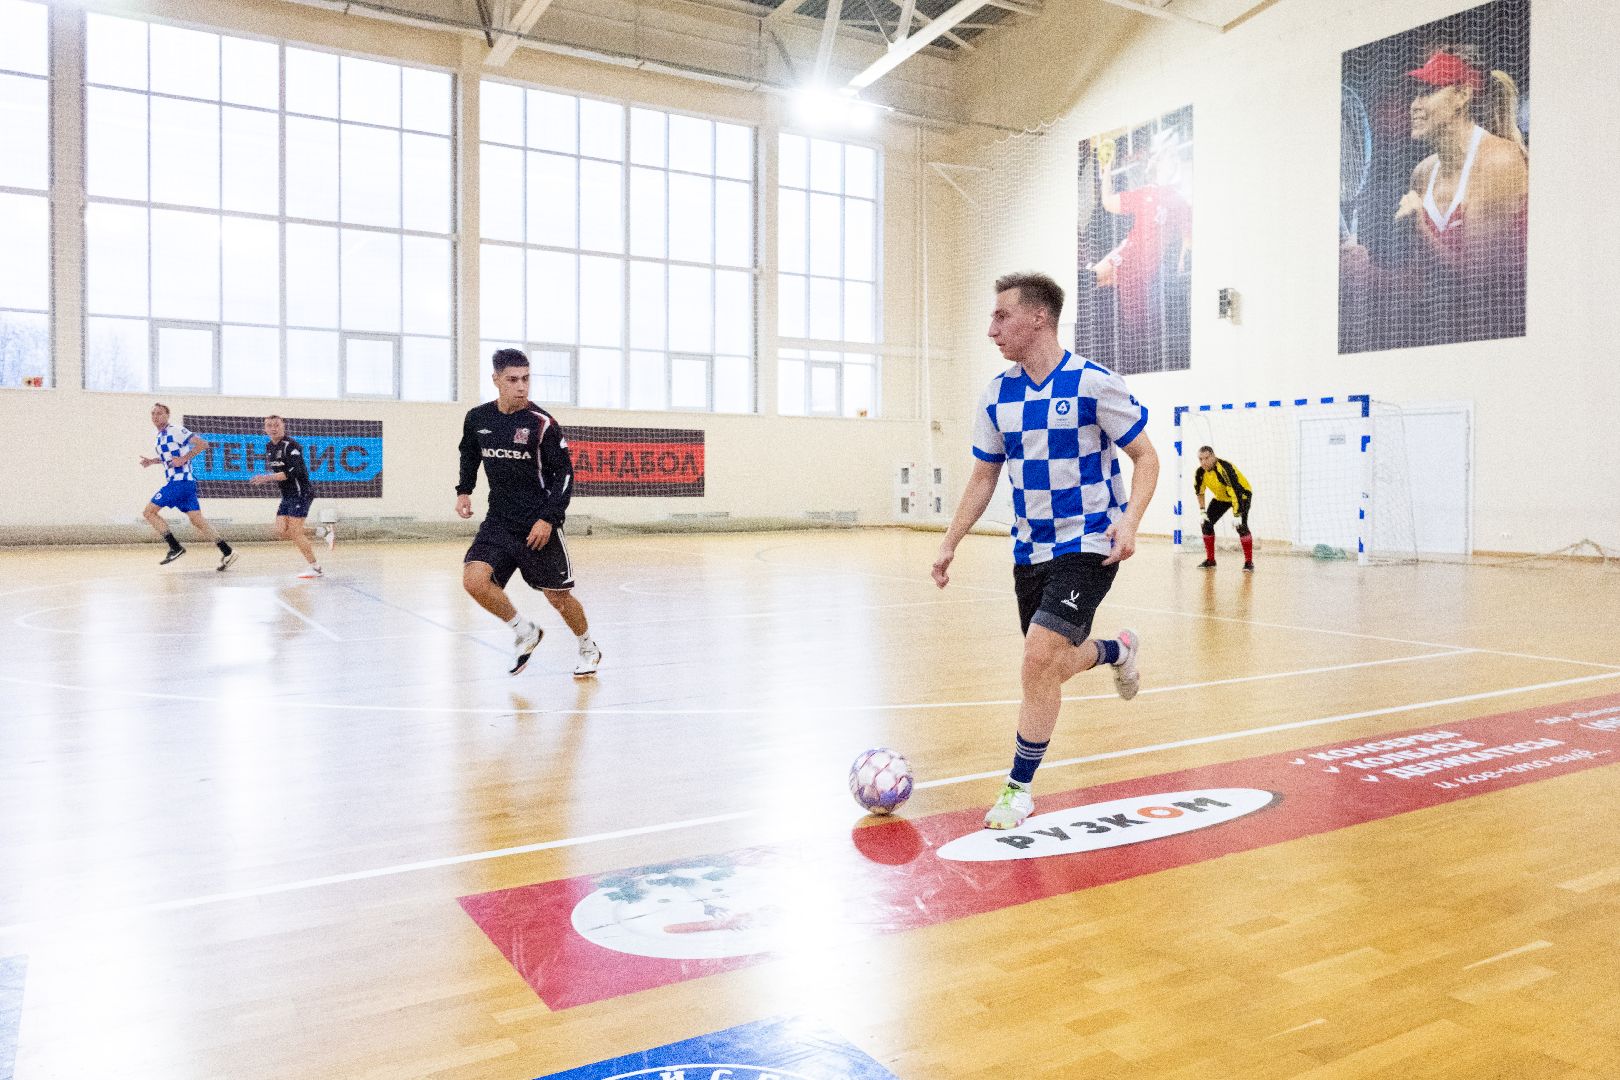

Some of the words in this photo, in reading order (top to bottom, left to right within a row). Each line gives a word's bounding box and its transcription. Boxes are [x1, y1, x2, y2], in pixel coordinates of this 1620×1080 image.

[205, 442, 368, 473] ТЕНИС
[568, 449, 699, 479] АНДБОЛ
[1308, 730, 1462, 761] КОНСЕРВЫ
[1342, 739, 1485, 769] КОЛБАСЫ
[1382, 737, 1566, 780] ДЕЛИКАТЕСЫ
[995, 796, 1232, 850] РУЗКОМ
